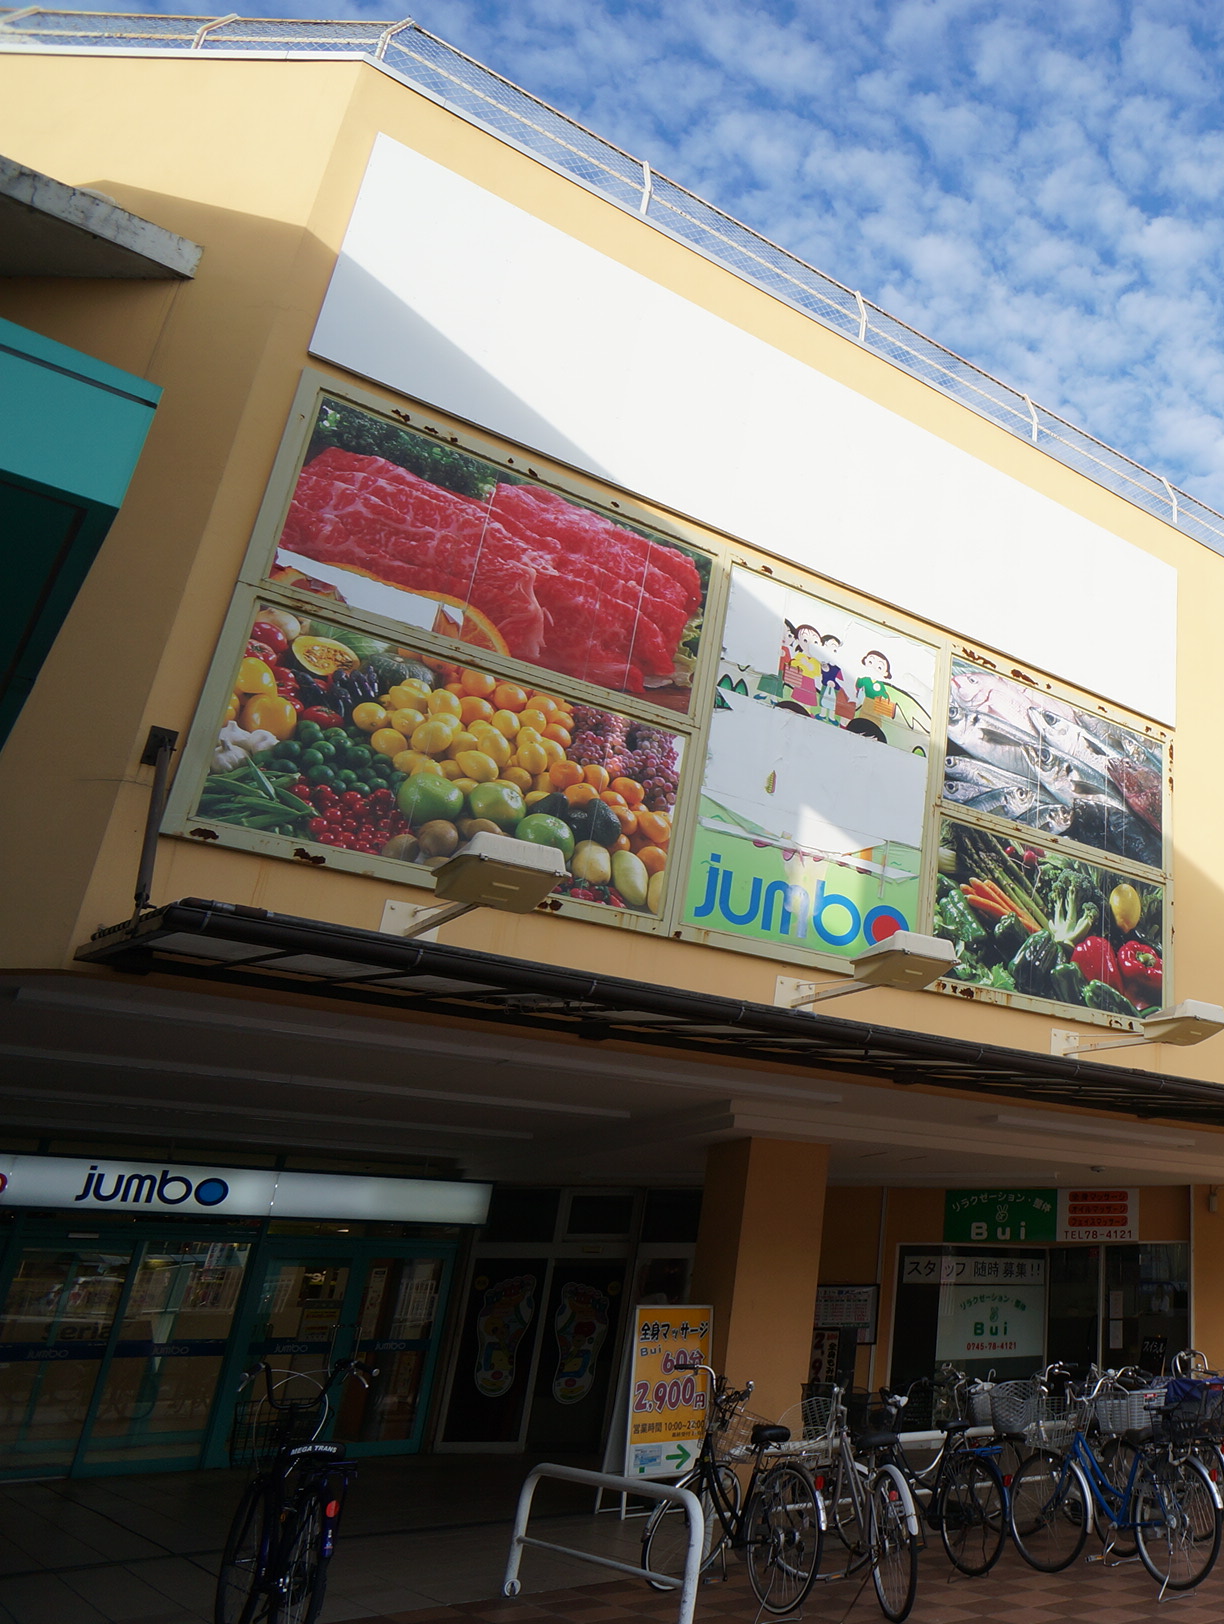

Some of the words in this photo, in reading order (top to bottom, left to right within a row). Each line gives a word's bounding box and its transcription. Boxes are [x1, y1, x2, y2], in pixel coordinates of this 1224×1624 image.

[694, 853, 909, 947] jumbo
[75, 1165, 229, 1206] jumbo
[971, 1221, 1026, 1240] Bui
[907, 1260, 966, 1277] スタッフ
[640, 1321, 709, 1342] 全身マッサージ
[974, 1322, 1008, 1336] Bui
[640, 1345, 662, 1357] Bui
[966, 1342, 1017, 1351] 0745-78-4121
[633, 1376, 706, 1413] 2,900円
[290, 1445, 313, 1456] MEGA
[314, 1445, 338, 1453] TRANS
